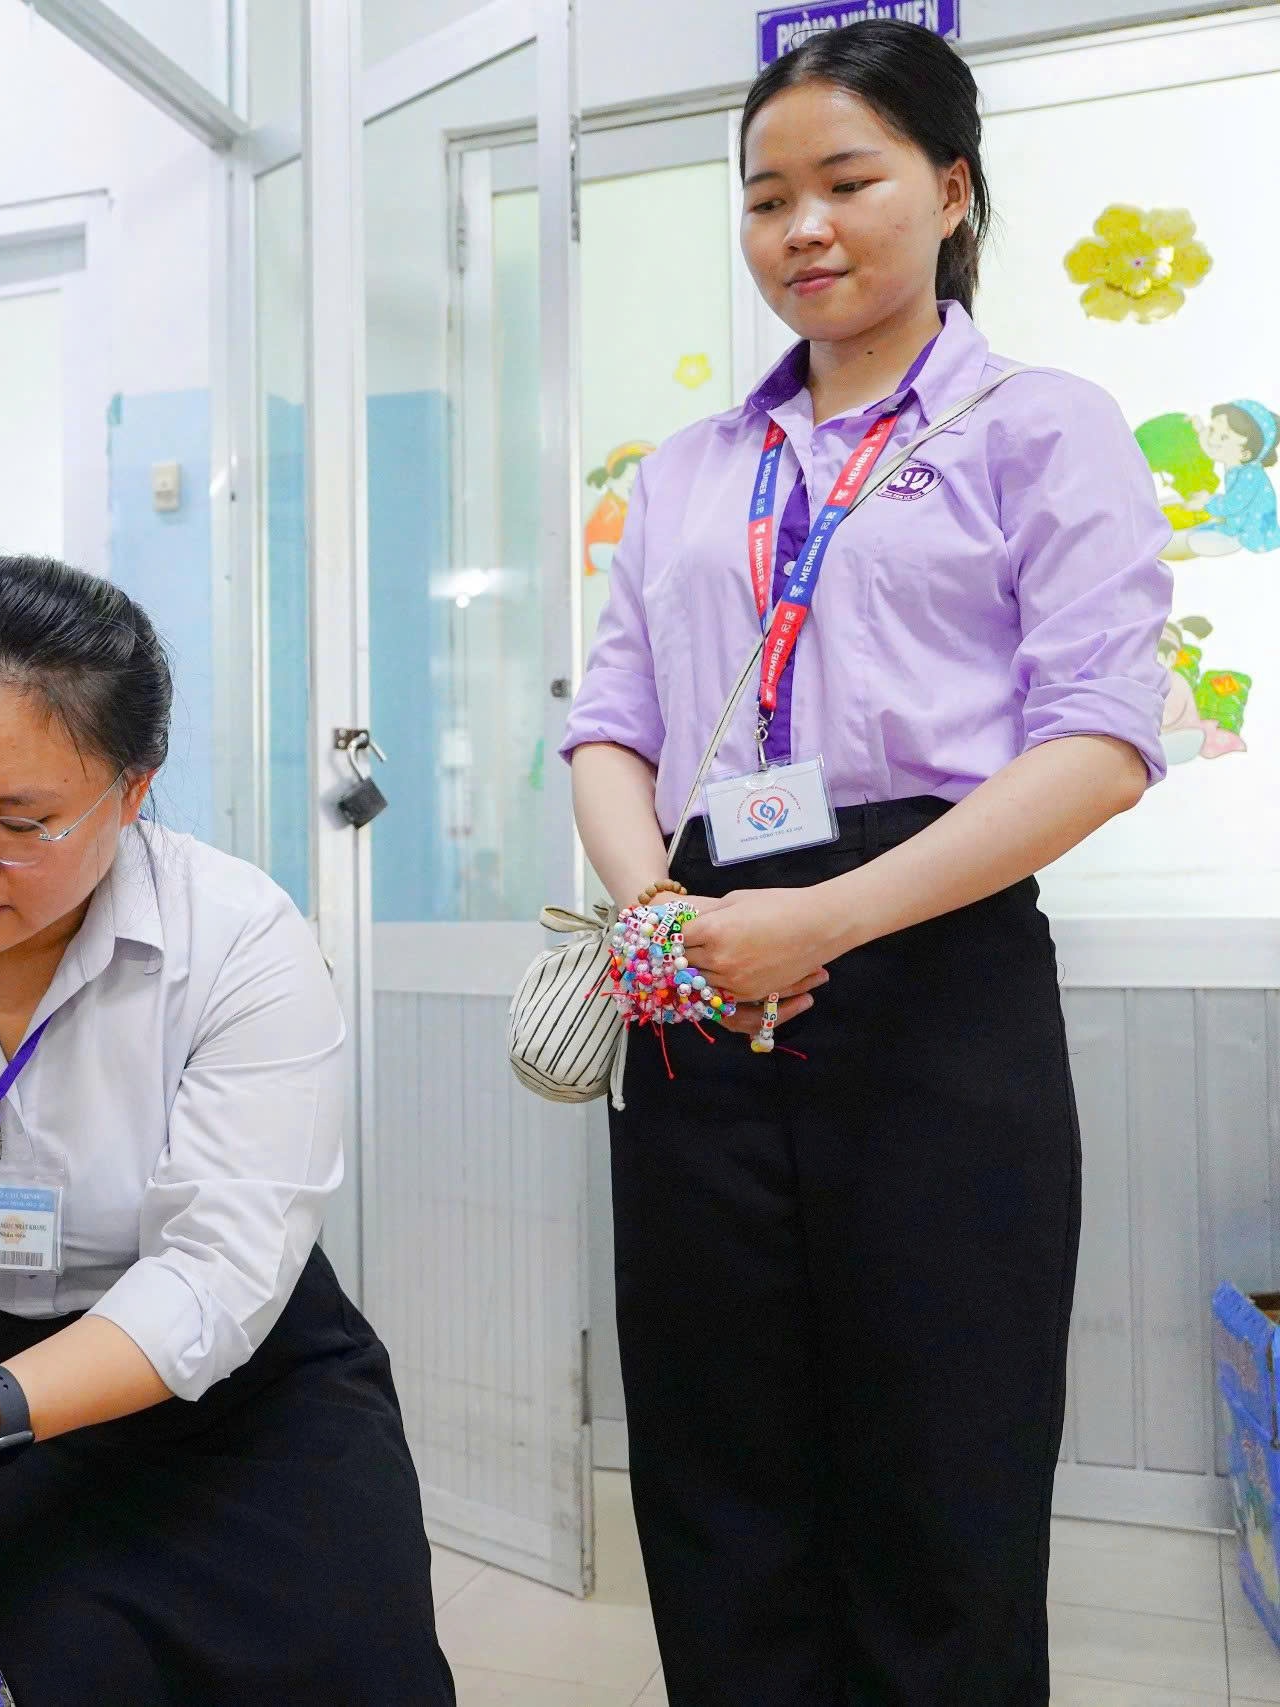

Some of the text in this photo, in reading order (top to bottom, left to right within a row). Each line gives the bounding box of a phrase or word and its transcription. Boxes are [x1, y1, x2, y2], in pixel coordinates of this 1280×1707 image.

[759, 461, 772, 495] MEMBER
[845, 446, 875, 486] MEMBER
[755, 538, 765, 582] MEMBER
[799, 535, 824, 582] MEMBER
